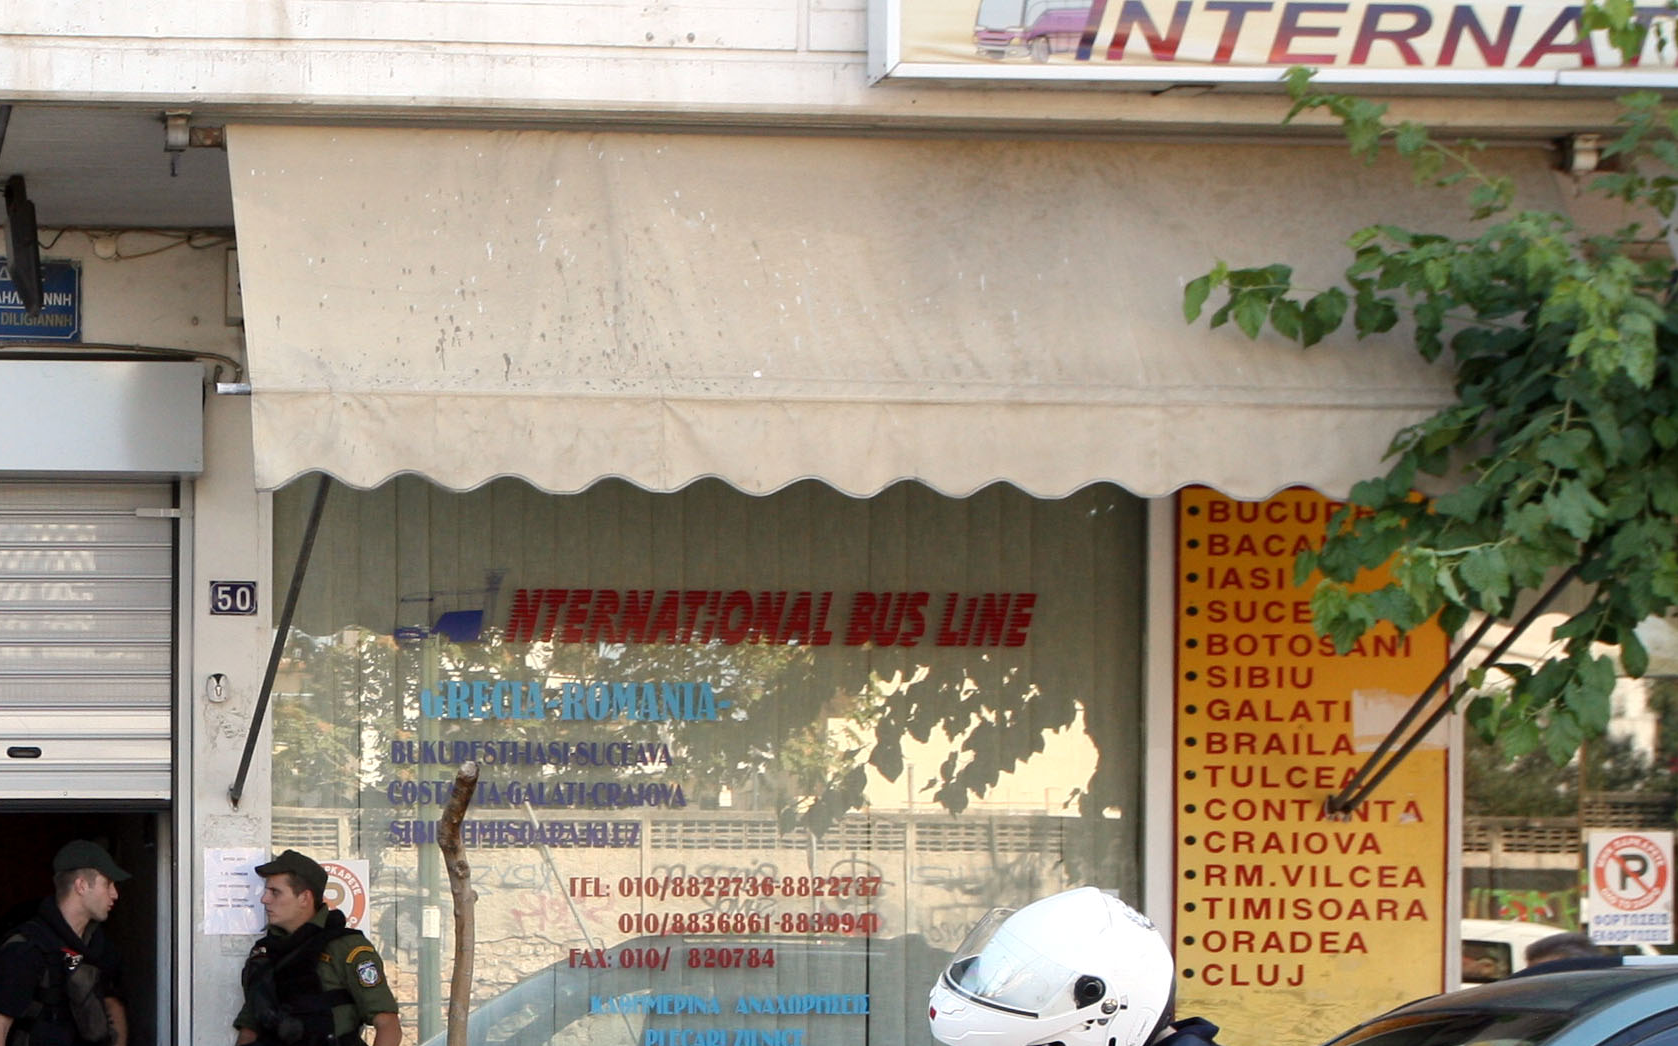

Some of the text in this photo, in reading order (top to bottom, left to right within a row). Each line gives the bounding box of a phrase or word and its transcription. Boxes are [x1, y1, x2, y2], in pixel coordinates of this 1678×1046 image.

[1206, 567, 1285, 591] IASI
[217, 586, 251, 611] 50
[843, 591, 930, 647] BUS
[935, 592, 1038, 648] LINE
[1206, 633, 1412, 658] BOTOSANI
[1206, 665, 1315, 689] SIBIU
[1206, 698, 1353, 723] GALATI
[1205, 732, 1356, 756] BRAILA
[1204, 765, 1363, 789] TULCEA
[1203, 830, 1383, 855] CRAIOVA
[569, 876, 610, 898] TEL:
[1204, 864, 1427, 889] RM.VILCEA
[1202, 897, 1429, 922] TIMISOARA
[1202, 930, 1369, 954] ORADEA
[569, 948, 611, 969] FAX:
[687, 948, 776, 969] 820784
[1201, 963, 1306, 987] CLUJ
